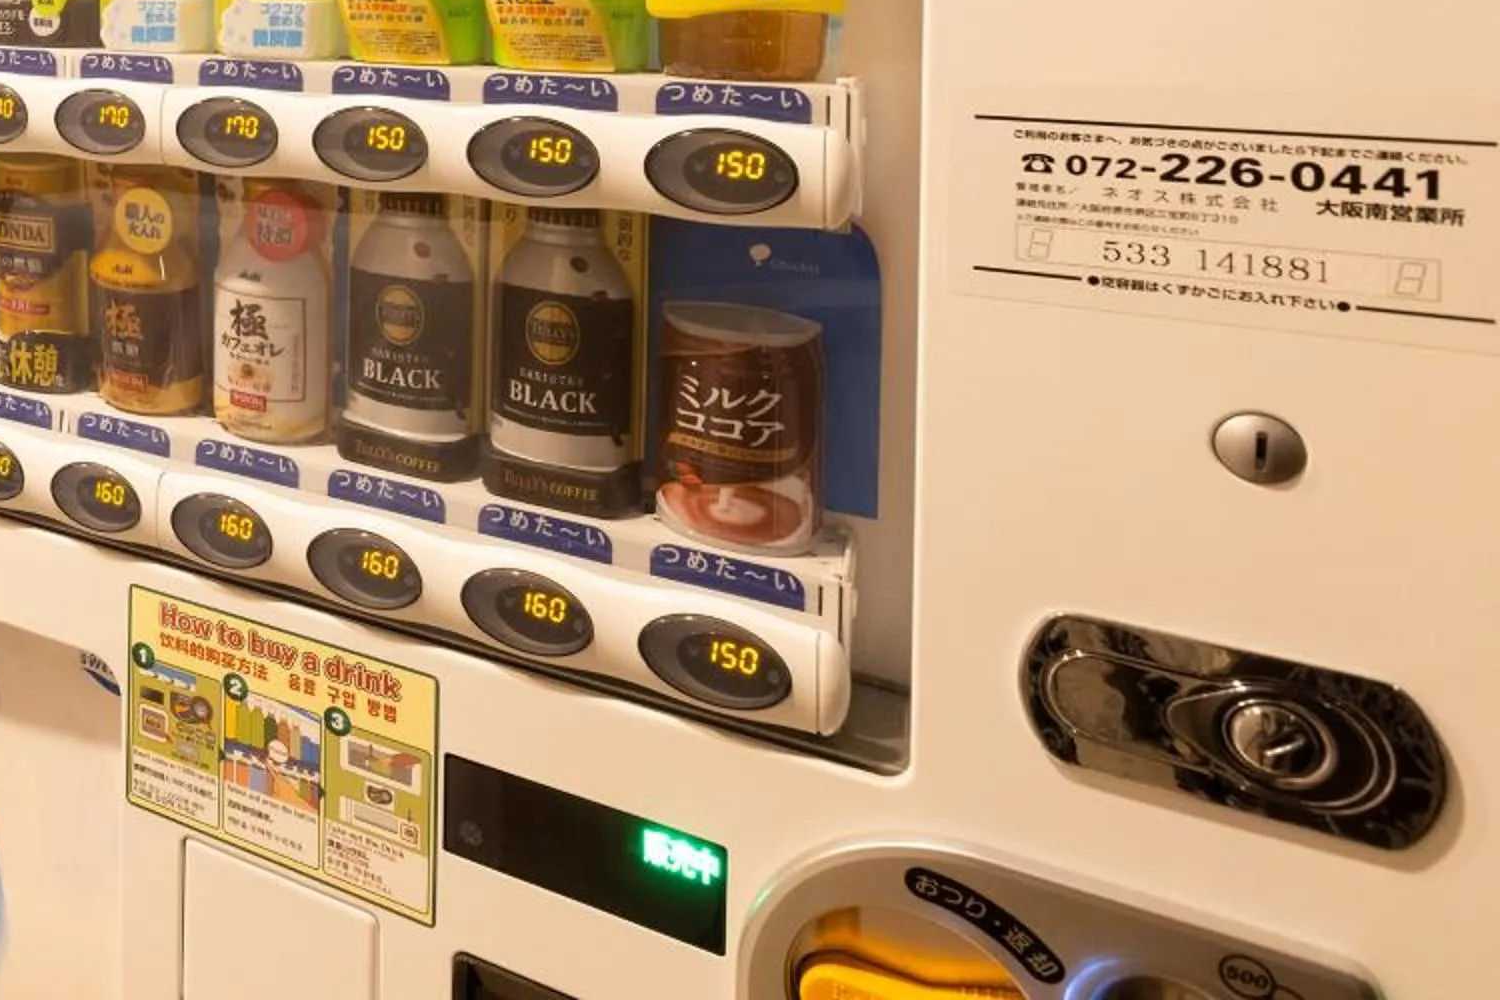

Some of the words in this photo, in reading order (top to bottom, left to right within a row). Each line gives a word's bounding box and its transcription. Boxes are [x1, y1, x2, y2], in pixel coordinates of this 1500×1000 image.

[99, 103, 130, 128] 170
[226, 114, 259, 138] 170
[368, 124, 405, 151] 150
[530, 137, 572, 163] 150
[717, 150, 765, 179] 150
[1065, 153, 1440, 201] 072-226-0441
[1316, 200, 1466, 227] 大阪南営業所
[1102, 240, 1171, 267] 533
[1196, 248, 1329, 284] 141881
[229, 298, 270, 341] 極
[221, 331, 286, 359] カフェオレ
[9, 341, 58, 387] 休憩
[363, 356, 442, 390] BLACK
[508, 378, 598, 416] BLACK
[680, 373, 784, 420] ミルク
[676, 407, 786, 449] ココア
[95, 481, 125, 506] 160
[220, 514, 255, 541] 160
[362, 551, 401, 579] 160
[524, 592, 566, 623] 160
[158, 601, 213, 638] How
[215, 620, 247, 651] to
[248, 629, 300, 670] buy
[301, 650, 323, 677] a
[322, 656, 404, 702] drink
[711, 642, 759, 675] 150
[228, 678, 244, 697] 2
[329, 712, 347, 731] 3
[914, 873, 1058, 979] おつり・返却
[1226, 963, 1269, 991] 500
